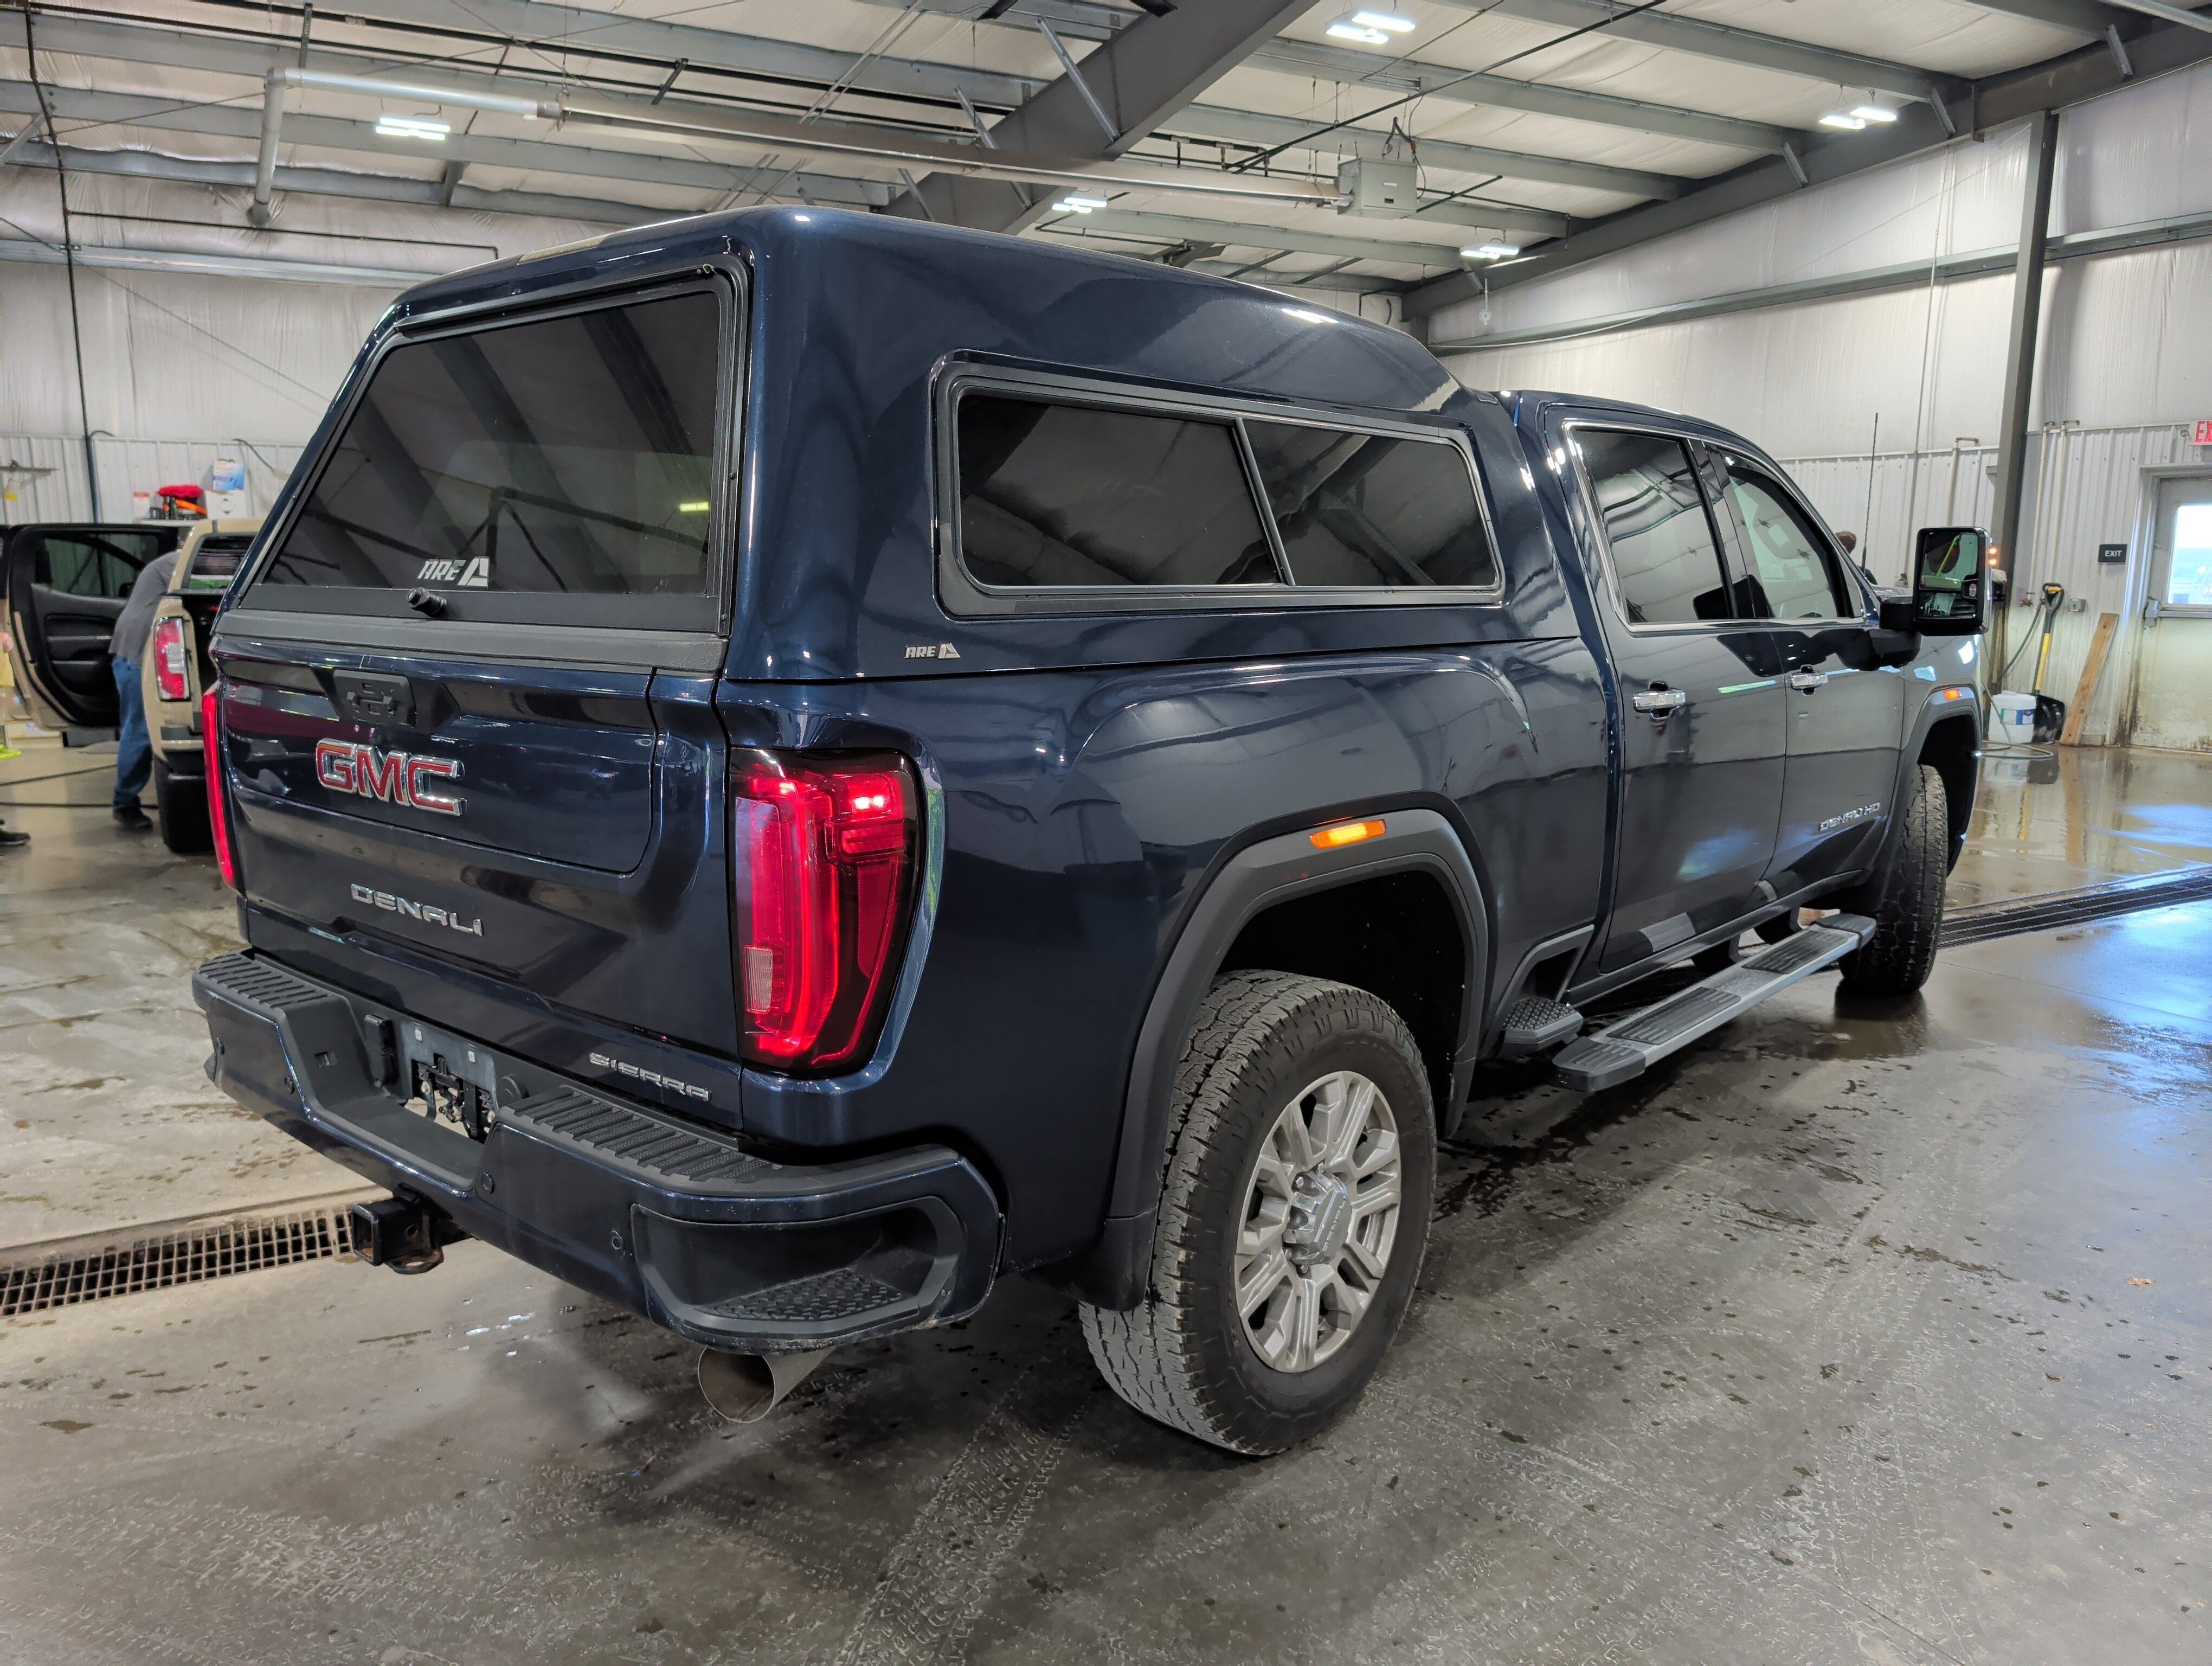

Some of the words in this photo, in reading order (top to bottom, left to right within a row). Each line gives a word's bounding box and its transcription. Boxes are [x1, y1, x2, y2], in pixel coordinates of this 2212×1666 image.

[416, 559, 466, 581] ARE
[903, 645, 937, 659] ARE
[316, 737, 467, 817] GMC
[351, 883, 484, 937] DENALI
[589, 1052, 712, 1102] SIERRA
